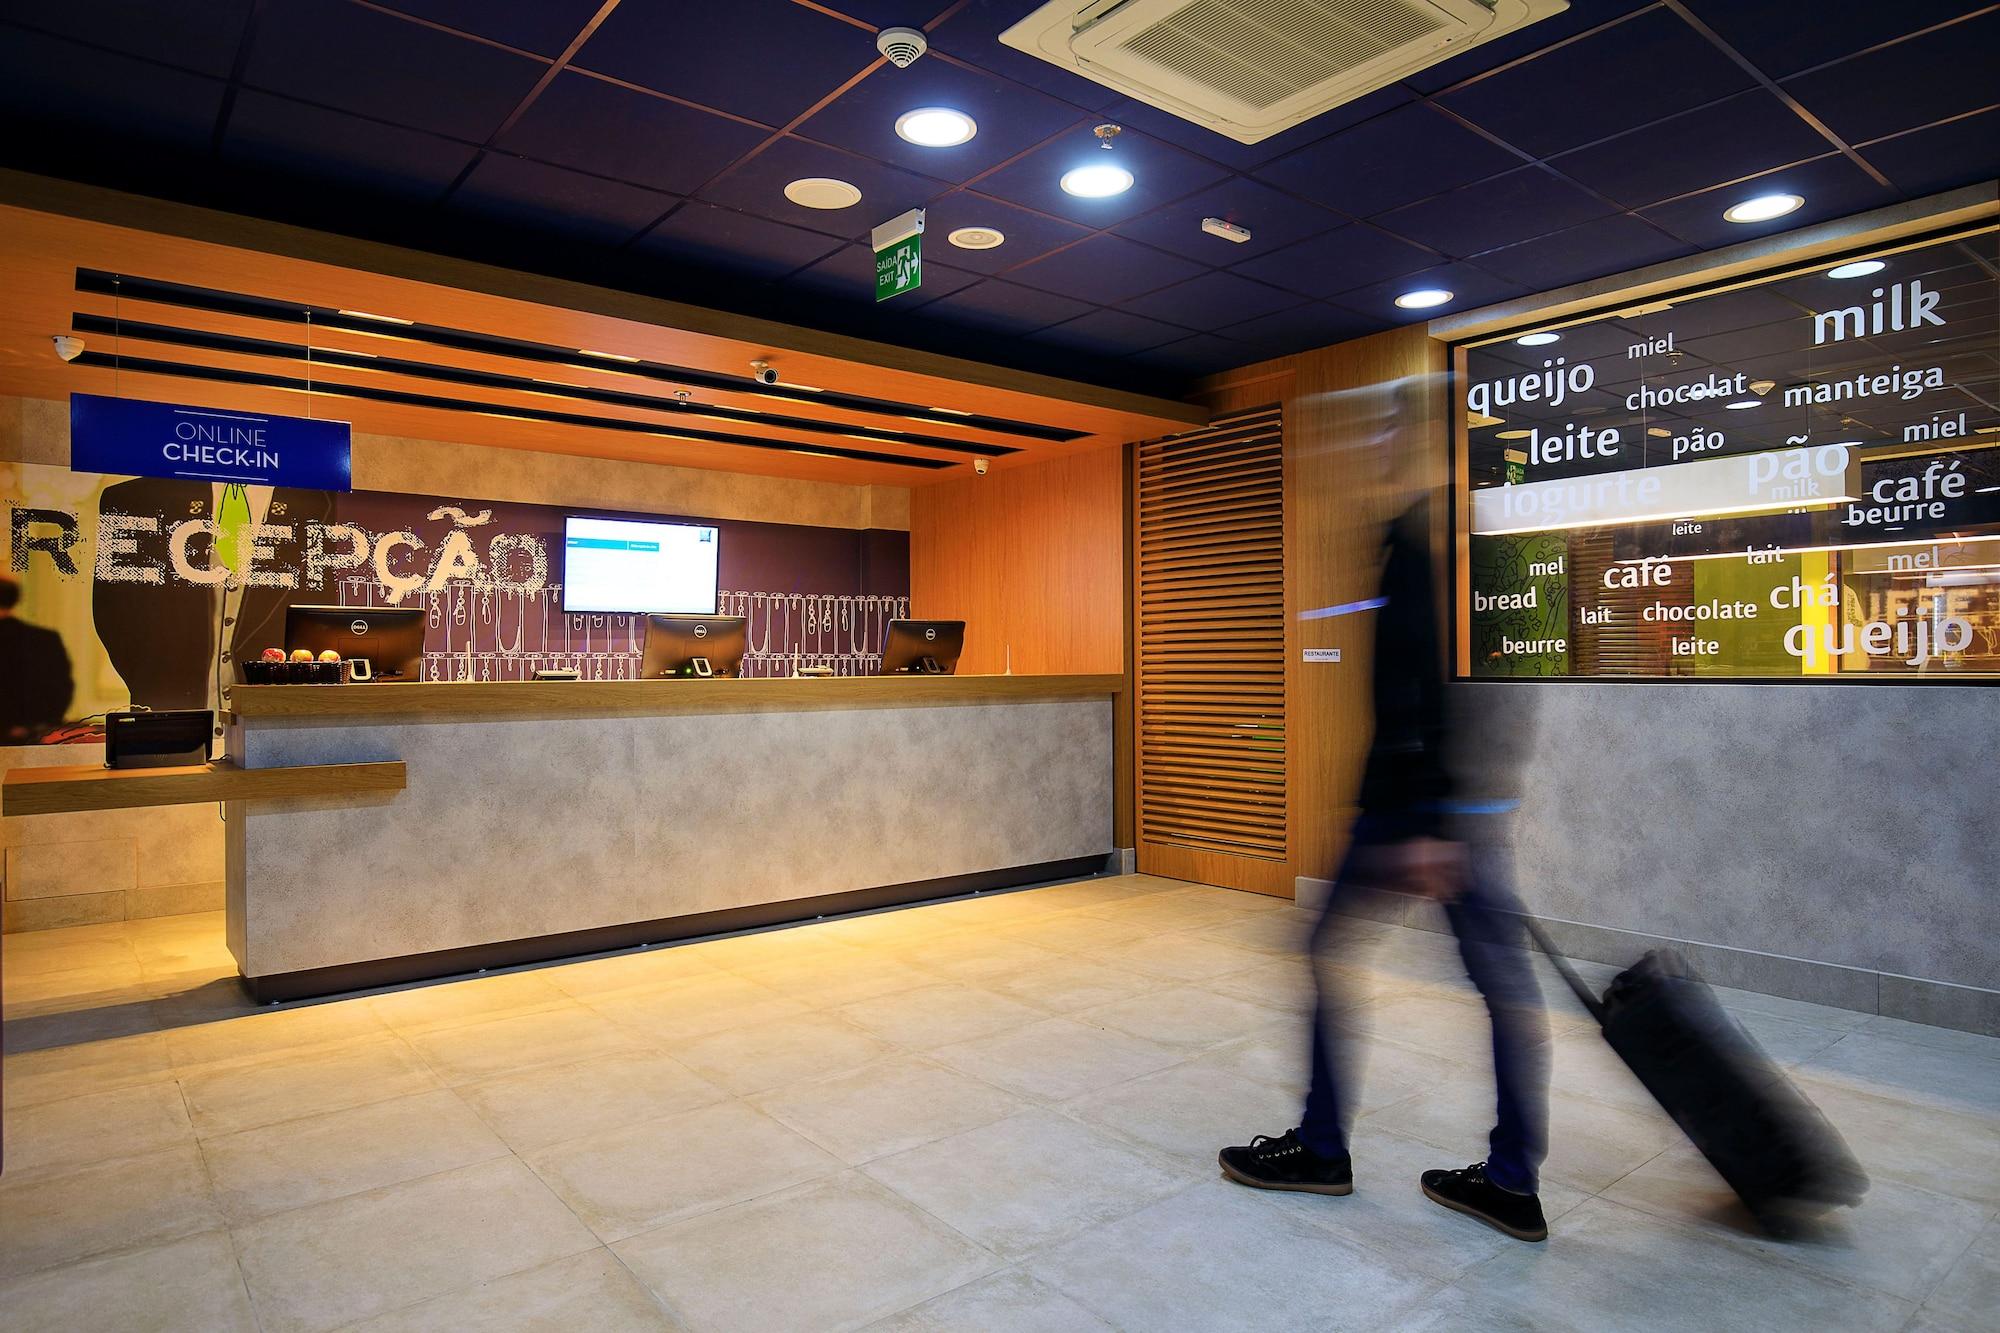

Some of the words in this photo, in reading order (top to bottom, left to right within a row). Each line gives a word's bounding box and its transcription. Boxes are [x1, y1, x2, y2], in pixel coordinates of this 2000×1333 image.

[880, 271, 894, 286] EXIT
[1814, 280, 1946, 344] milk
[1628, 332, 1674, 359] miel
[1467, 357, 1595, 418] queijo
[1625, 372, 1747, 411] chocolat
[1784, 365, 1943, 407] manteiga
[175, 422, 266, 447] ONLINE
[1903, 413, 1966, 442] miel
[163, 443, 279, 469] CHECK-IN
[1530, 423, 1620, 465] leite
[1672, 427, 1725, 460] pão
[1748, 435, 1849, 496] pão
[1771, 478, 1821, 501] milk
[1872, 460, 1966, 503] café
[1503, 474, 1661, 526] iogurte
[1849, 502, 1945, 526] beurre
[1672, 522, 1702, 536] leite
[10, 503, 548, 604] RECEPÇÃO
[1529, 556, 1564, 576] mel
[1746, 544, 1784, 564] lait
[1887, 544, 1940, 570] mel
[1603, 555, 1672, 589] café
[1474, 586, 1537, 611] bread
[1770, 572, 1839, 609] chá
[1580, 606, 1613, 624] lait
[1642, 599, 1758, 621] chocolate
[1502, 636, 1567, 655] beurre
[1672, 636, 1719, 656] leite
[1783, 607, 1974, 667] queijo
